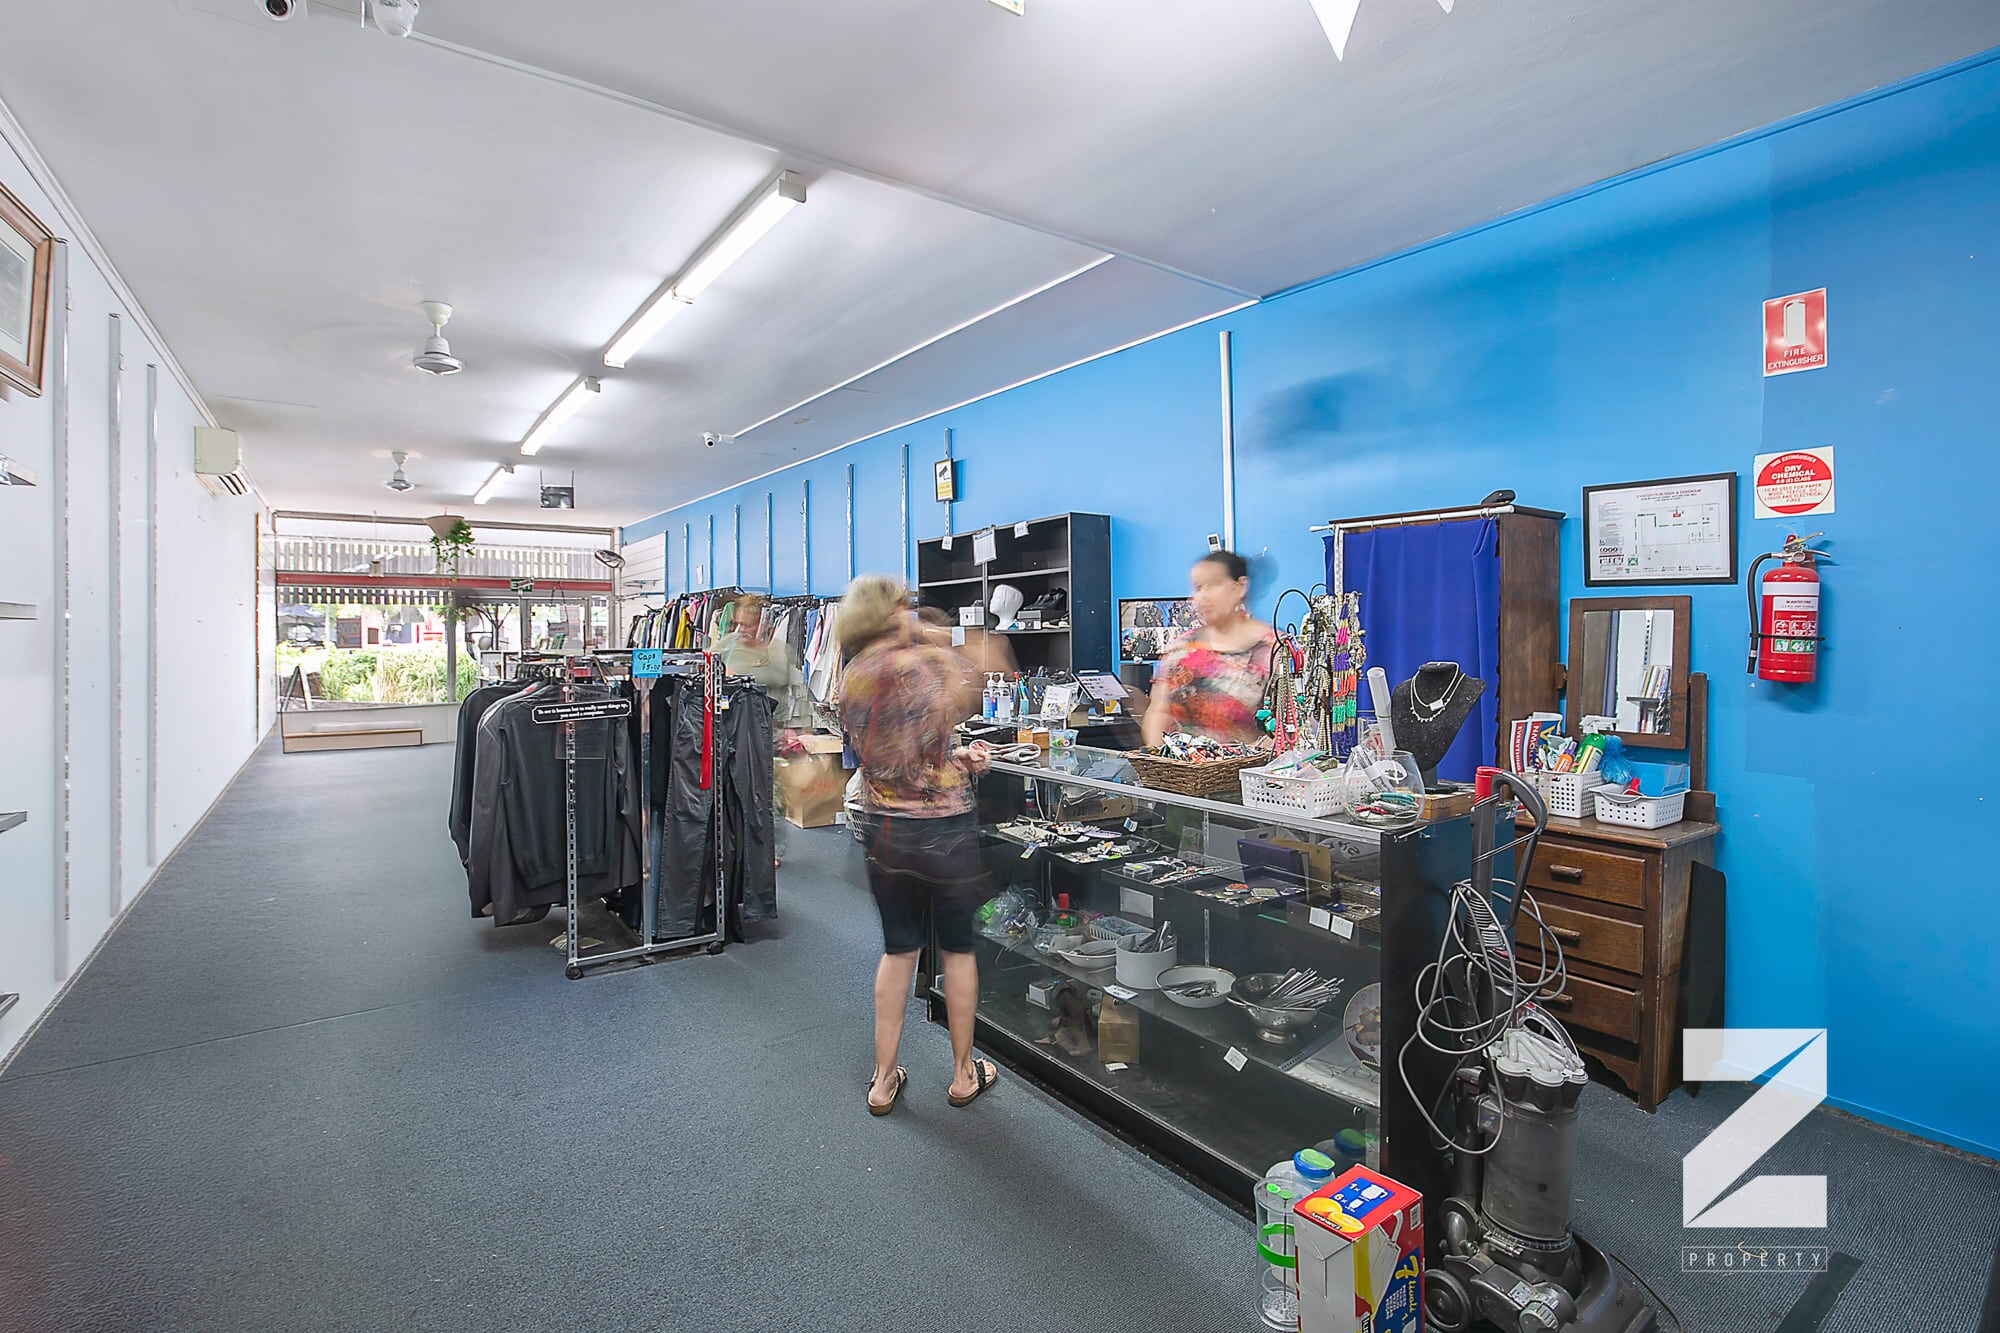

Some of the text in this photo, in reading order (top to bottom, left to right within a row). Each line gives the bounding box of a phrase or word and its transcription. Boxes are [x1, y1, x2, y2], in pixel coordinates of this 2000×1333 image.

[1784, 348, 1806, 357] FIRE
[1768, 354, 1823, 370] EXTINGUISHER
[1771, 469, 1816, 480] CHEMICAL
[637, 652, 656, 663] Caps
